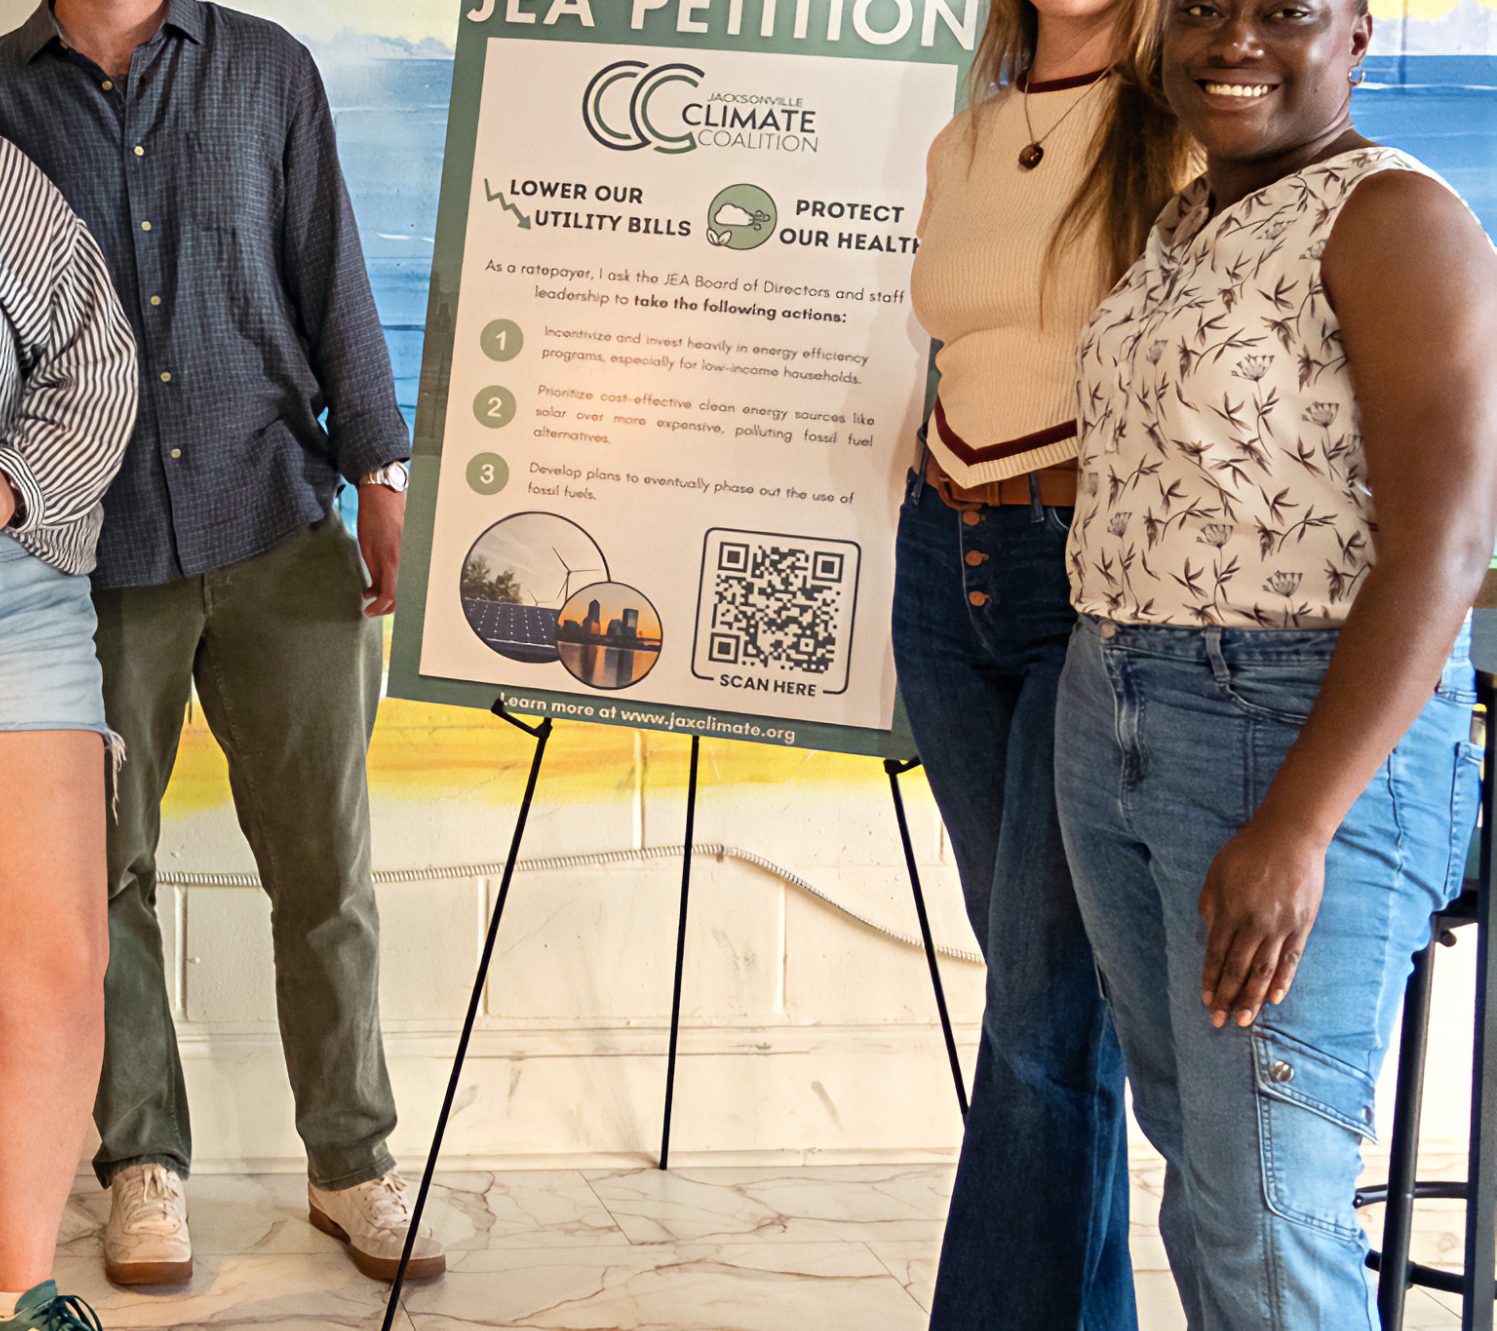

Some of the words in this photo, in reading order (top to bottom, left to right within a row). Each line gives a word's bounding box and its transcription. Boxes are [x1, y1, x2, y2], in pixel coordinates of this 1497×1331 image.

[707, 93, 803, 107] JACKSONVILLE
[682, 103, 816, 133] CLIMATE
[698, 129, 818, 153] COALITION
[510, 179, 587, 200] LOWER
[595, 185, 643, 204] OUR
[535, 210, 622, 231] UTILITY
[628, 217, 691, 236] BILLS
[795, 199, 905, 223] PROTECT
[779, 228, 828, 247] OUR
[485, 259, 502, 272] As
[507, 264, 516, 273] a
[521, 263, 594, 282] ratepayer,
[608, 269, 630, 282] ask
[636, 272, 658, 285] the
[663, 273, 690, 286] JEA
[695, 275, 738, 292] Board
[743, 280, 758, 292] of
[764, 280, 830, 299] Directors
[835, 288, 864, 301] and
[869, 290, 905, 304] staff
[535, 285, 609, 307] leadership
[615, 294, 628, 305] to
[634, 294, 668, 309] take
[674, 296, 698, 311] the
[703, 298, 776, 320] following
[781, 309, 846, 323] actions:
[496, 330, 506, 351] 1
[544, 326, 612, 342] Incentivize
[616, 333, 641, 345] and
[646, 336, 682, 348] invest
[688, 336, 732, 355] heavily
[736, 342, 748, 353] in
[753, 345, 798, 361] energy
[802, 347, 869, 367] efficiency
[541, 348, 606, 363] programs,
[610, 355, 675, 371] especially
[679, 357, 697, 370] for
[701, 359, 779, 377] low-income
[783, 366, 862, 385] households.
[487, 396, 502, 418] 2
[538, 384, 593, 400] Prioritize
[600, 391, 692, 411] cost-effective
[699, 398, 735, 413] clean
[742, 405, 788, 421] energy
[794, 410, 846, 424] sources
[853, 412, 875, 426] like
[533, 425, 612, 444] alternatives.
[535, 407, 567, 419] solar
[576, 411, 604, 422] over
[613, 415, 647, 426] more
[657, 419, 724, 435] expensive,
[735, 425, 793, 443] polluting
[804, 429, 837, 444] fossil
[848, 434, 873, 447] fuel
[480, 464, 495, 484] 3
[529, 462, 582, 480] Develop
[586, 468, 621, 482] plans
[626, 473, 639, 484] to
[644, 476, 710, 494] eventually
[714, 480, 754, 495] phase
[759, 487, 781, 498] out
[786, 487, 807, 500] the
[812, 493, 834, 503] use
[840, 492, 855, 505] of
[528, 482, 559, 497] fossil
[564, 486, 597, 500] fuels.
[719, 673, 770, 692] SCAN
[773, 681, 817, 697] HERE
[551, 701, 595, 717] more
[598, 706, 617, 720] at
[621, 710, 795, 744] www.jaxclimate.org
